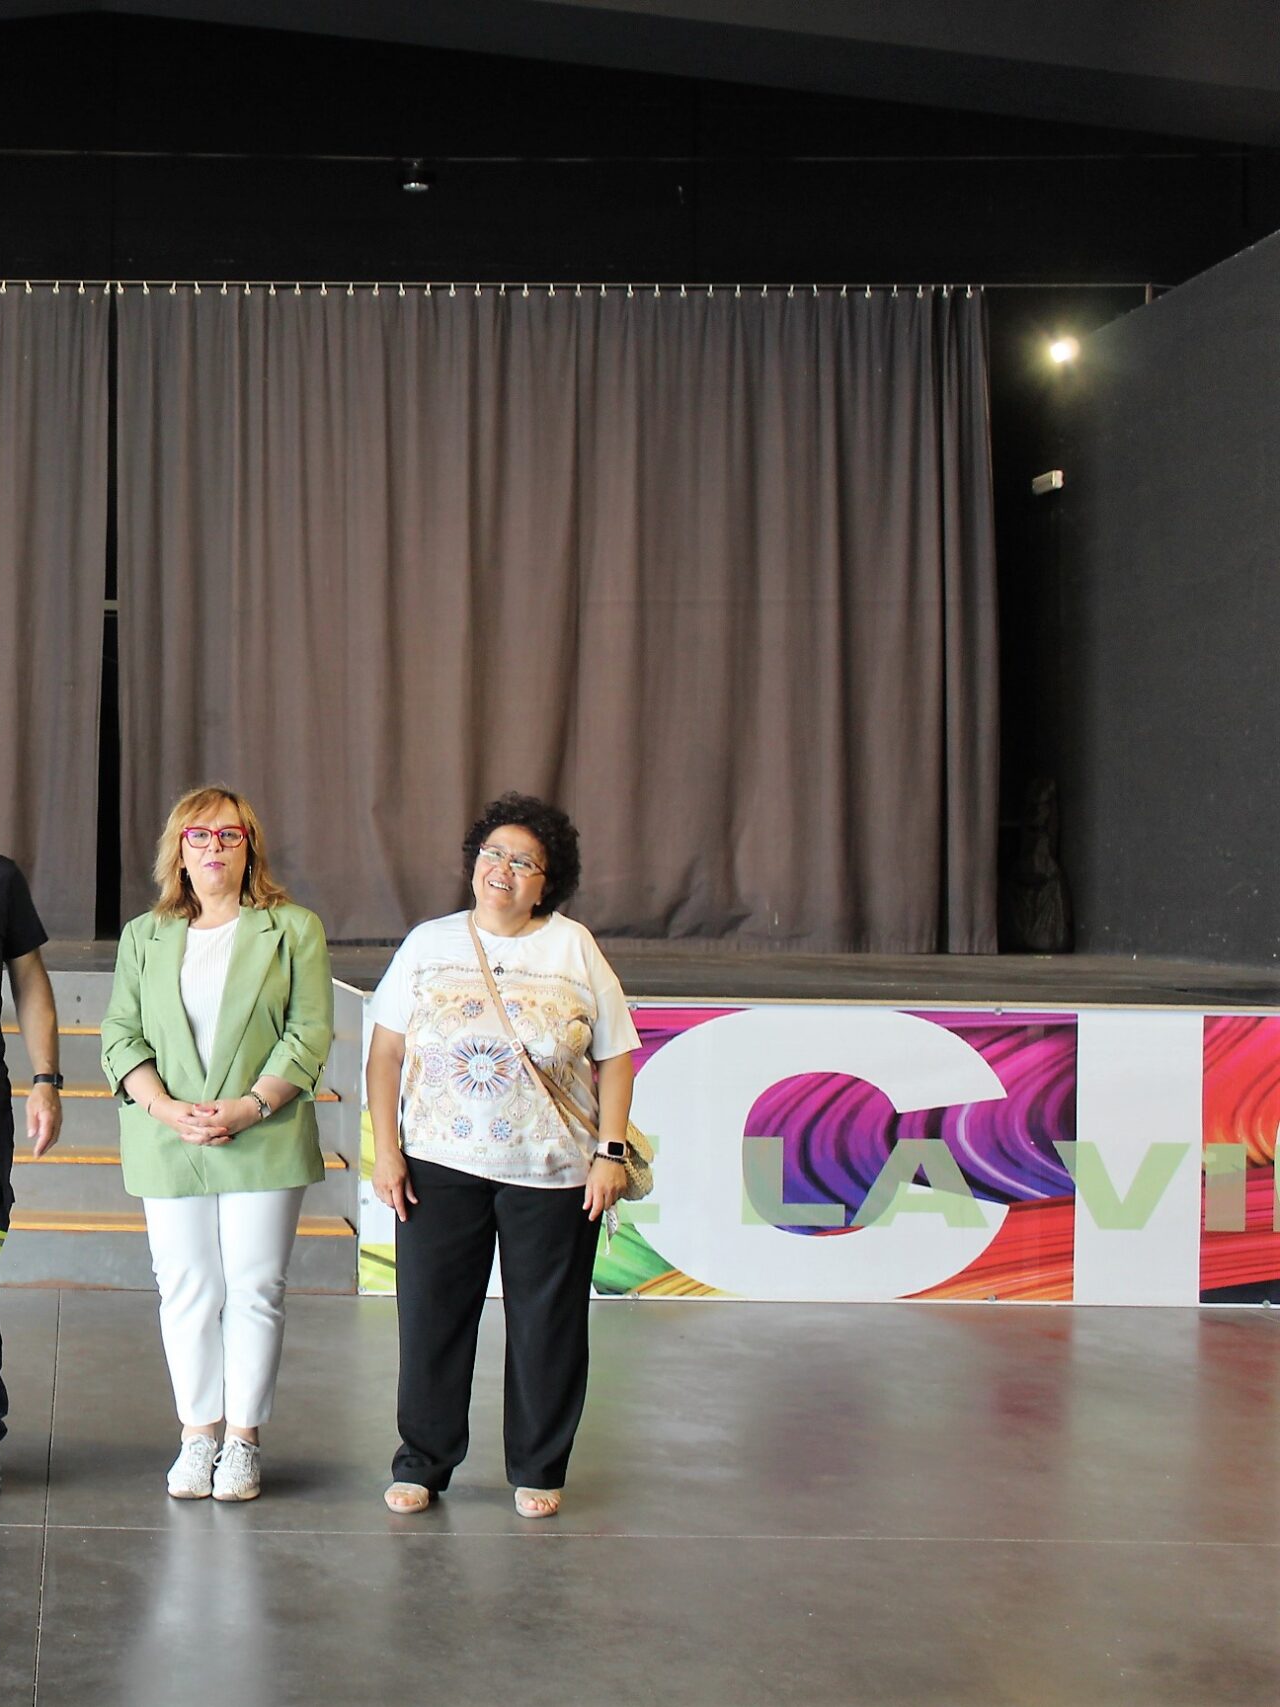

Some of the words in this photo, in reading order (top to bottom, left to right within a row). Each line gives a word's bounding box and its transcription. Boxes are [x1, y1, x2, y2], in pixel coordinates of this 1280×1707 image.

[613, 1007, 1280, 1304] CI
[741, 1136, 989, 1229] LA
[1053, 1140, 1280, 1232] VI
